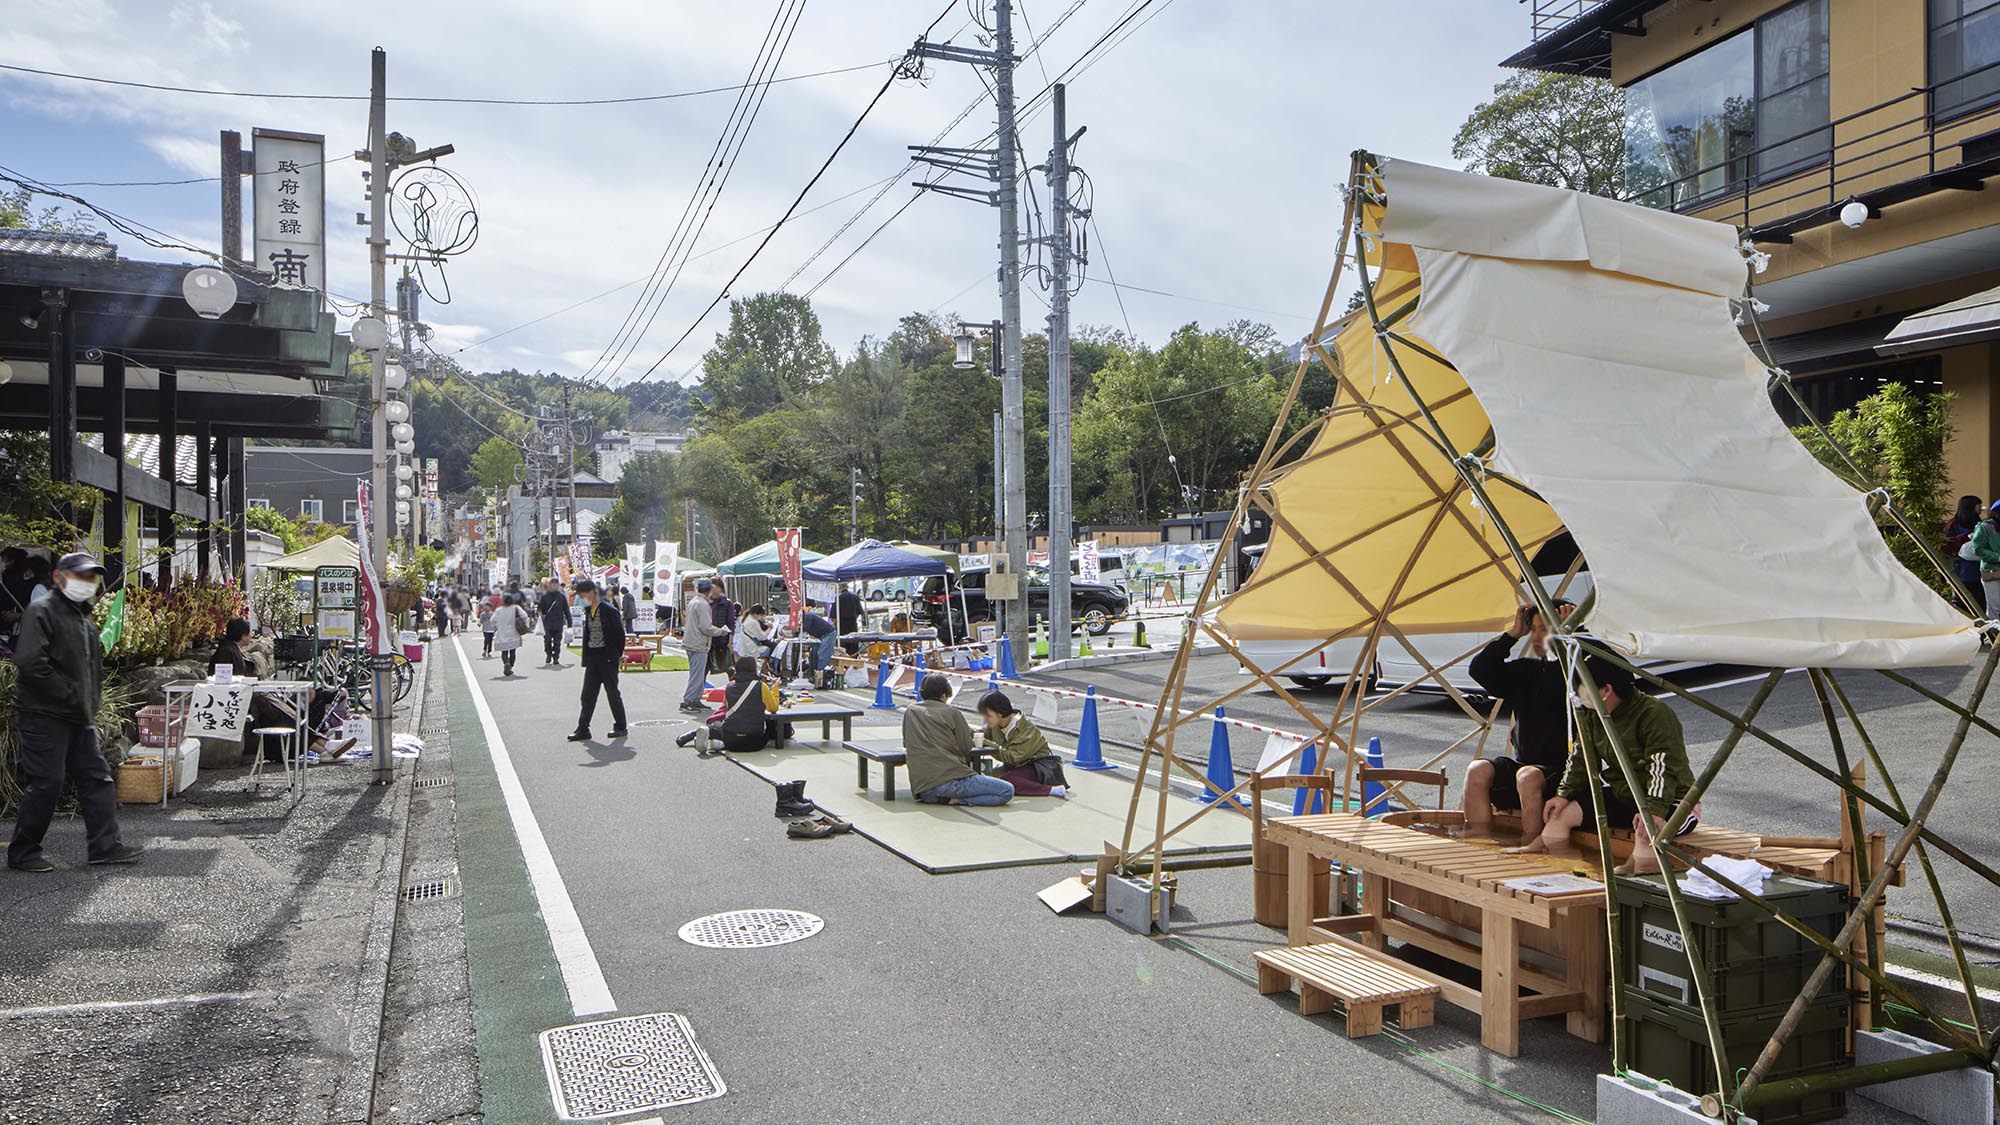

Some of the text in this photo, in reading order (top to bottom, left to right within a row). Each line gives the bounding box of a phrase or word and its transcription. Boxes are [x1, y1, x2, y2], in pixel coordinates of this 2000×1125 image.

[278, 160, 301, 235] 政府登録
[269, 248, 309, 286] 南
[320, 582, 353, 593] 温泉場中
